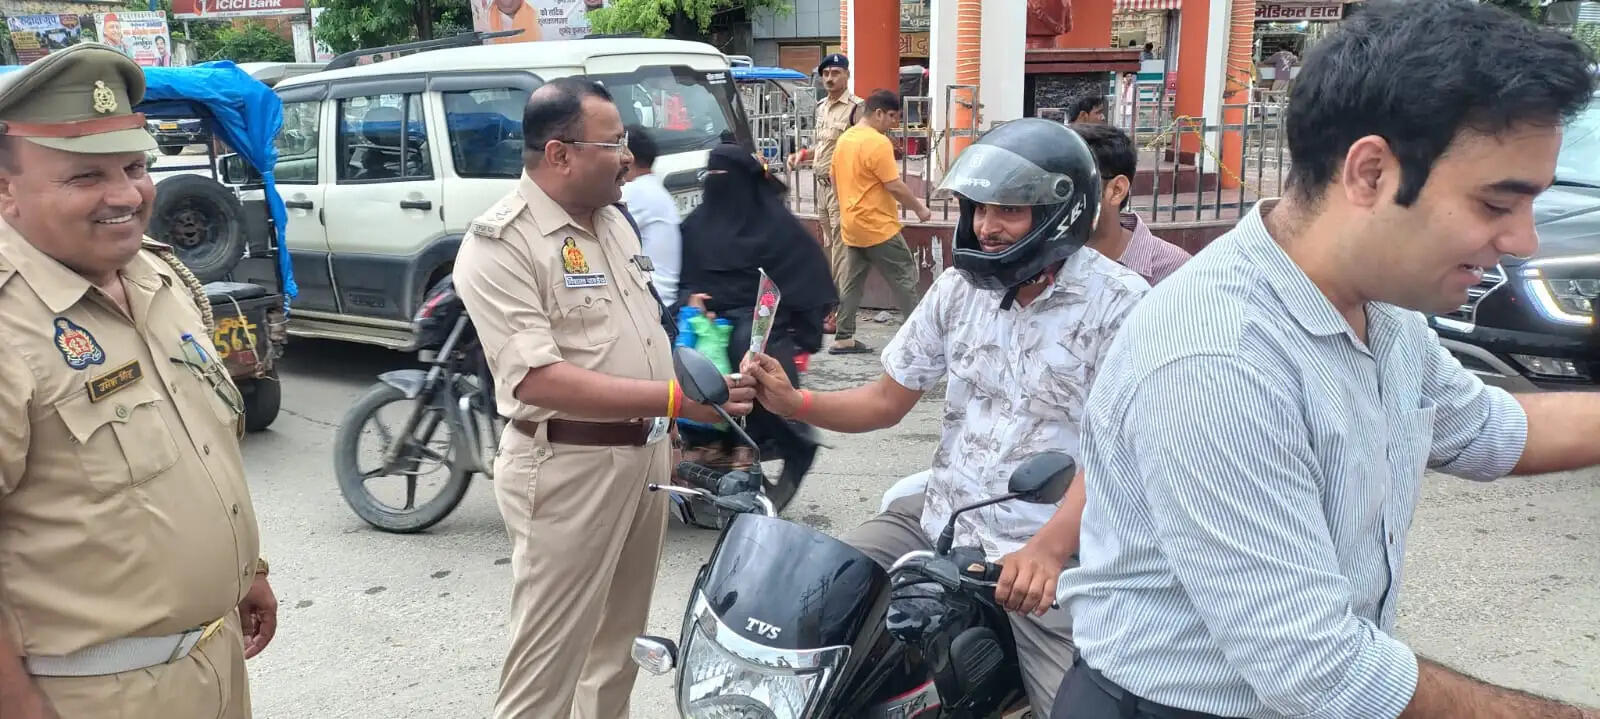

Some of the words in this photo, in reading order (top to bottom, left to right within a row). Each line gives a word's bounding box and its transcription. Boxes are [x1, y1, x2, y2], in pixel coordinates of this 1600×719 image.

[215, 0, 246, 9] ICICI
[249, 0, 281, 8] Bank
[1310, 6, 1340, 17] हाल
[745, 617, 782, 640] TVS
